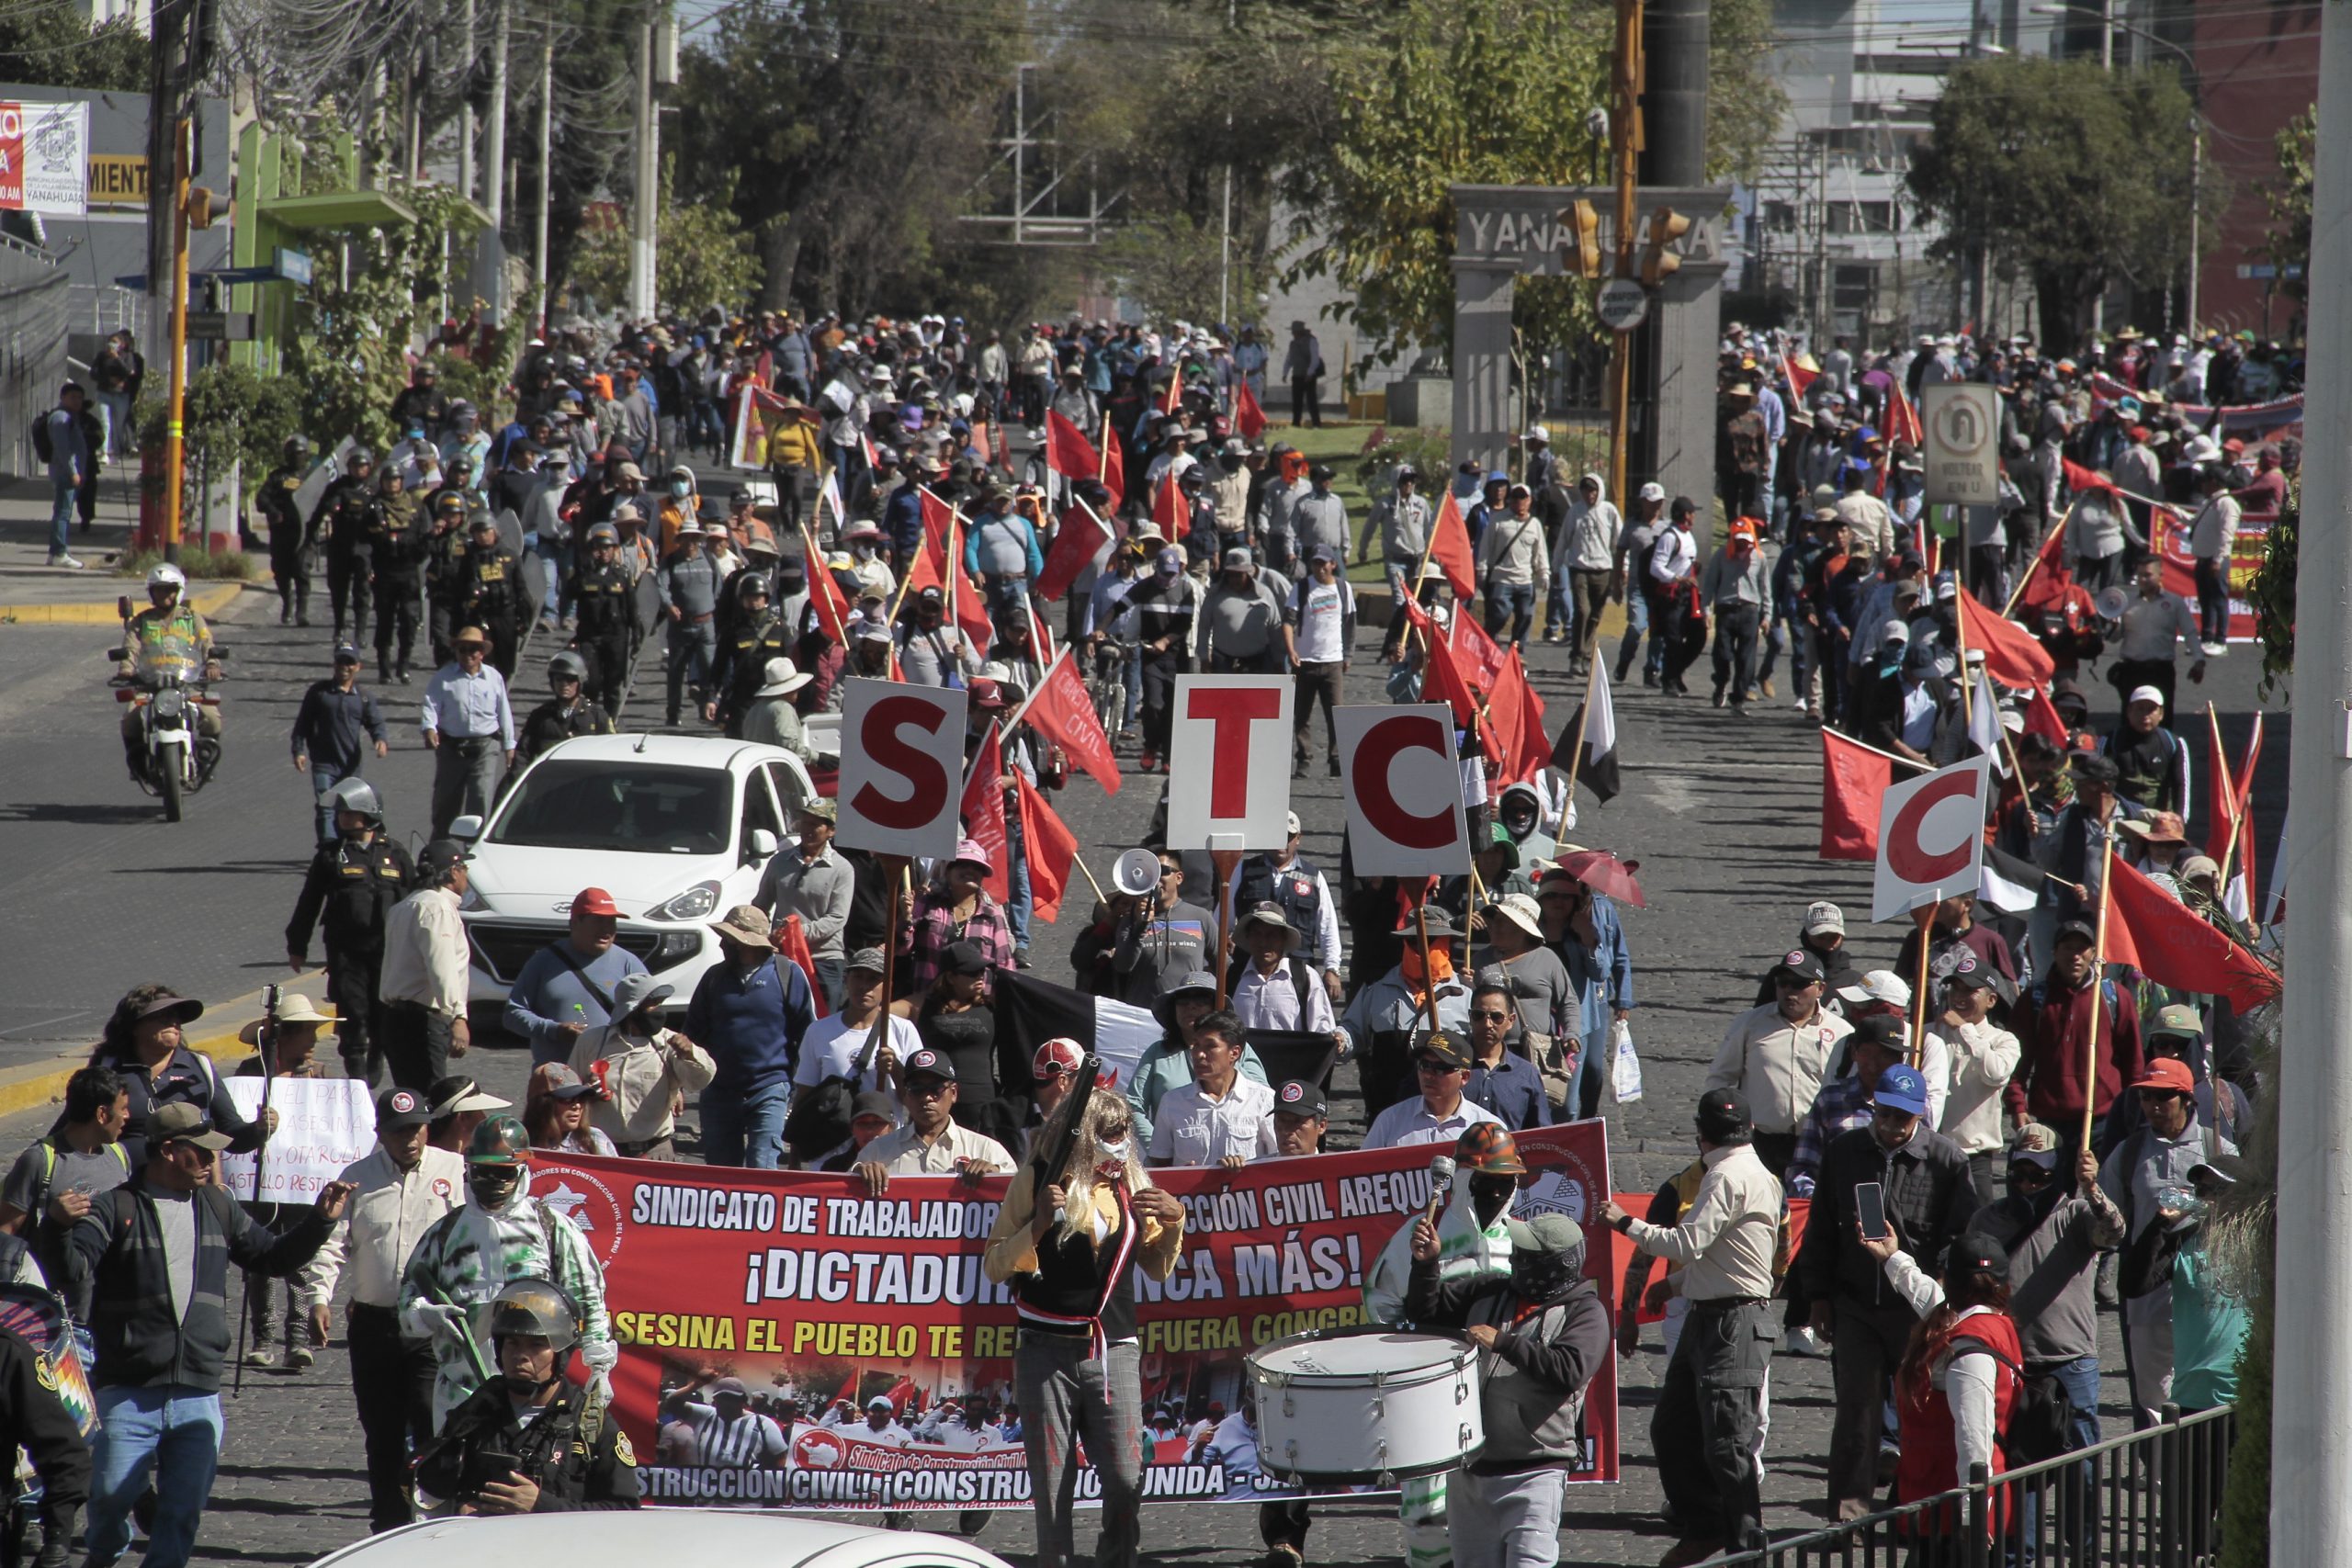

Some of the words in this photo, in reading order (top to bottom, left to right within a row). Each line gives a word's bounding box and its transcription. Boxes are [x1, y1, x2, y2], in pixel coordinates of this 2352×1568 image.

[1941, 462, 1984, 476] VOLTEAR
[1948, 481, 1966, 493] EN
[1972, 481, 1980, 493] U
[851, 695, 948, 830] S
[1065, 713, 1101, 758] CIVIL
[1187, 688, 1281, 819] T
[1351, 716, 1459, 850] C
[1886, 769, 1979, 884] C
[611, 1202, 622, 1222] CIVIL
[631, 1182, 775, 1232] SINDICATO
[781, 1195, 820, 1235] DE
[826, 1198, 1005, 1239] TRABAJADOR
[1264, 1181, 1334, 1226] CIVIL
[744, 1248, 1015, 1305] ¡DICTADUR
[1234, 1230, 1363, 1297] MÁS!
[606, 1310, 736, 1351] SESINA
[745, 1319, 783, 1354] EL
[793, 1321, 917, 1358] PUEBLO
[927, 1325, 963, 1358] TE
[974, 1325, 1022, 1358] RE
[1251, 1305, 1369, 1346] CONGR
